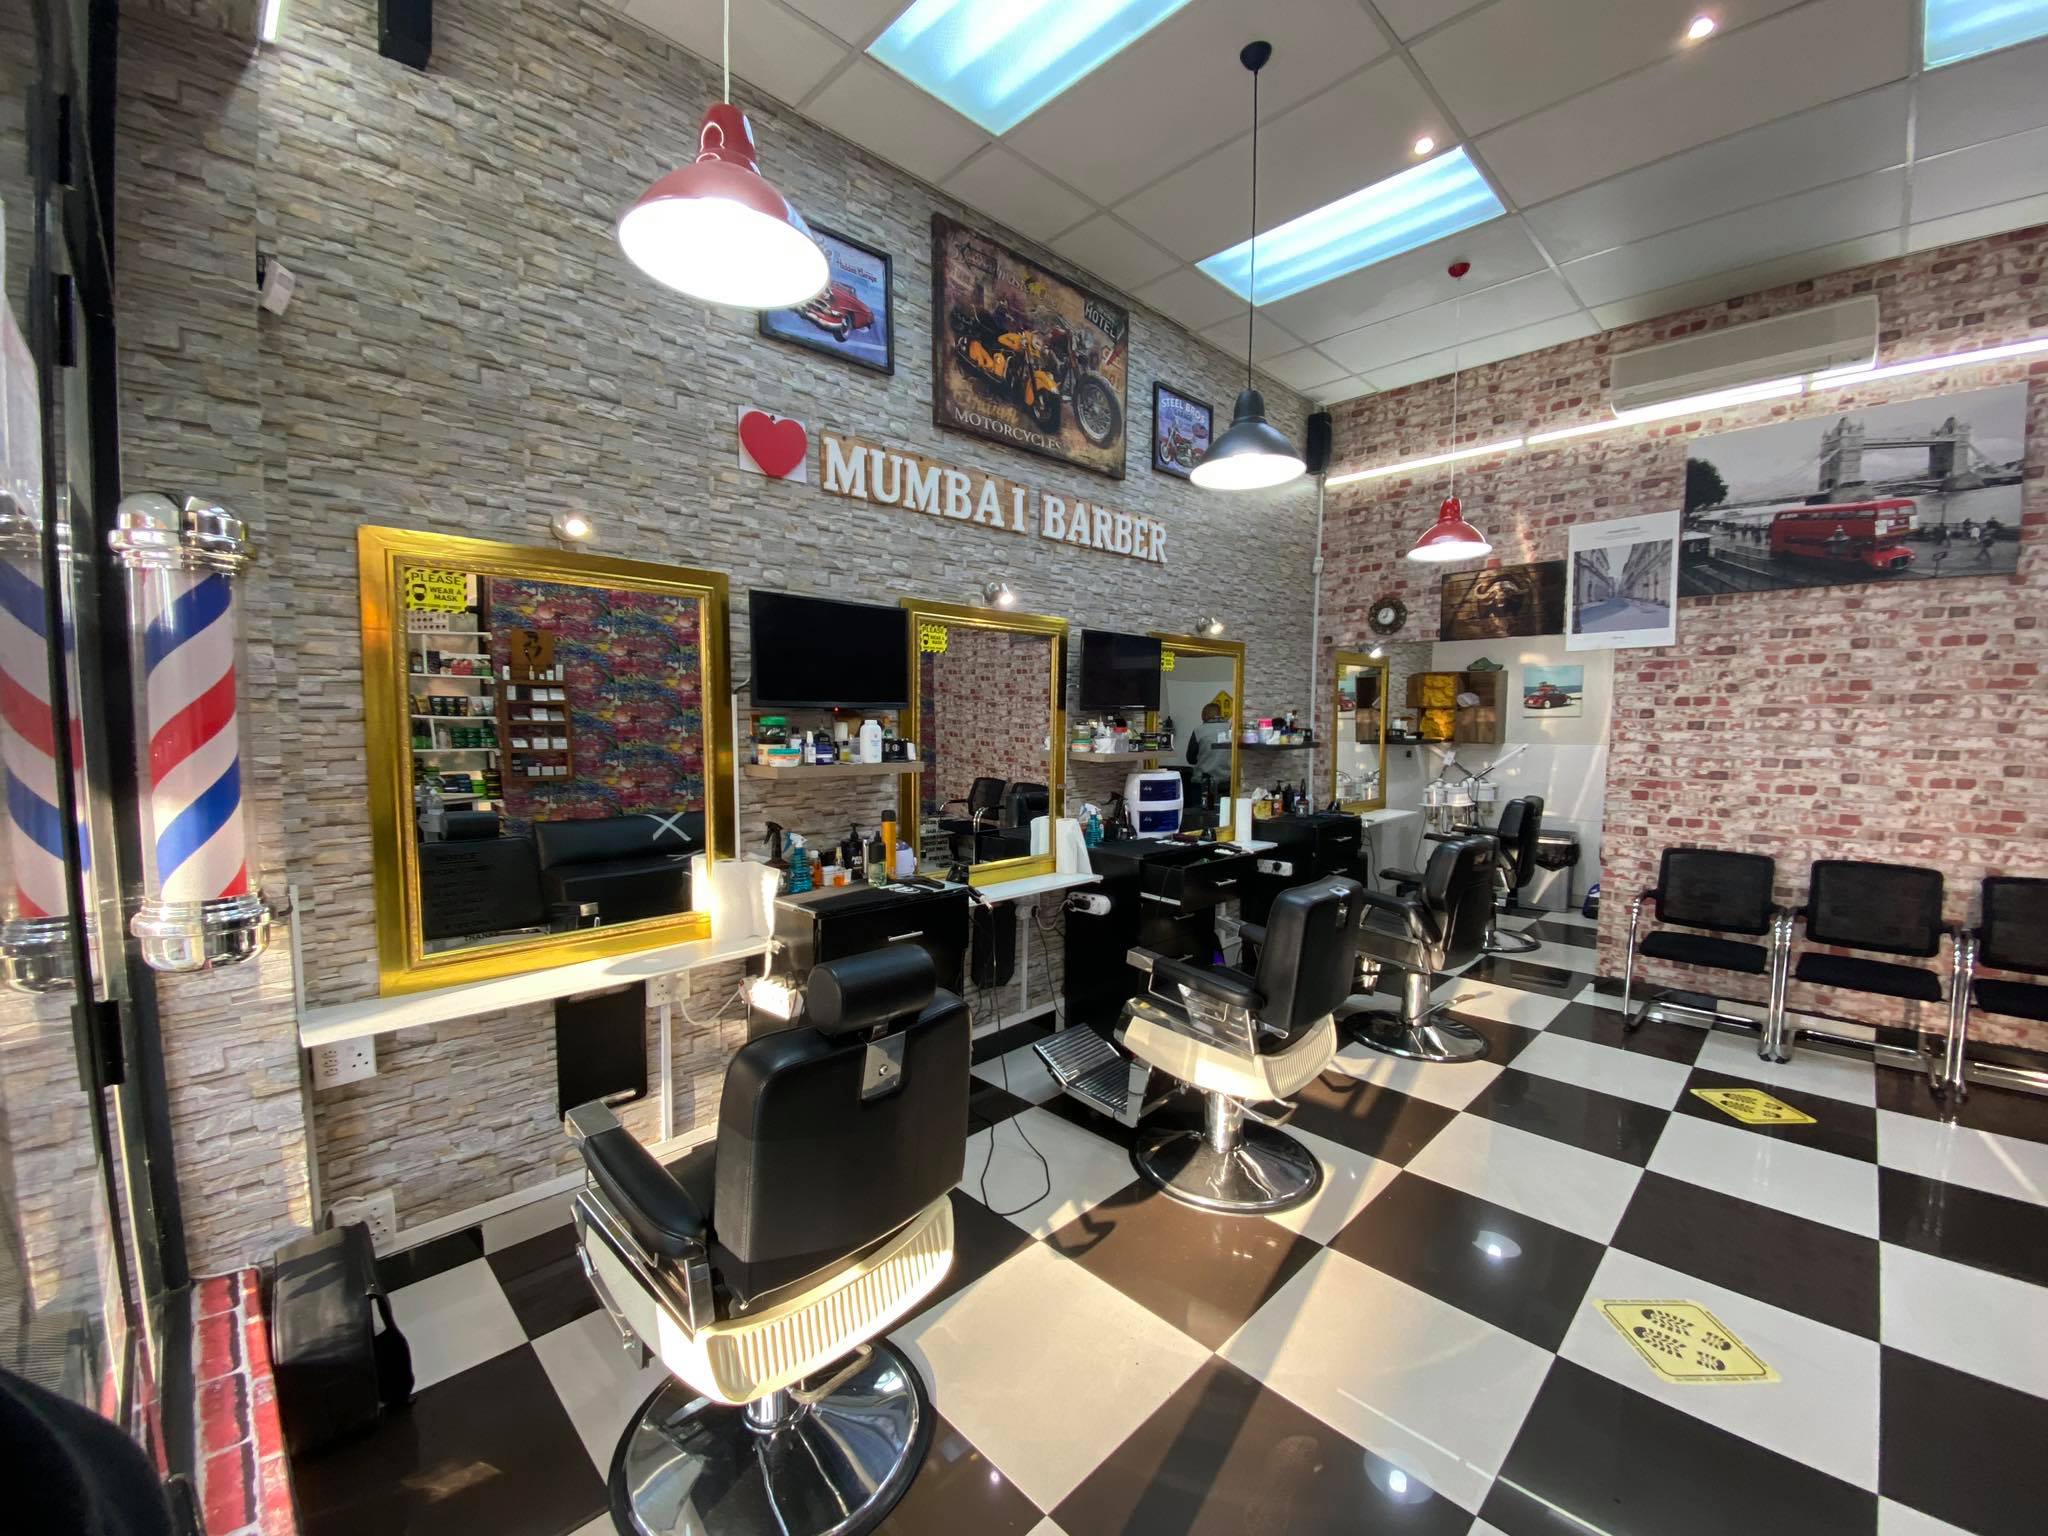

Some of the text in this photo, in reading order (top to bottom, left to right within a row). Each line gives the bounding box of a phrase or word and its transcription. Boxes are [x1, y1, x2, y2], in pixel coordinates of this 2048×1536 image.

[1085, 304, 1117, 339] HOTEL
[1161, 398, 1184, 410] STEEL
[954, 407, 1062, 449] MOTORCYCLES
[823, 437, 1168, 563] MUMBAI BARBER
[411, 572, 462, 585] PLEASE
[430, 587, 454, 595] WEAR
